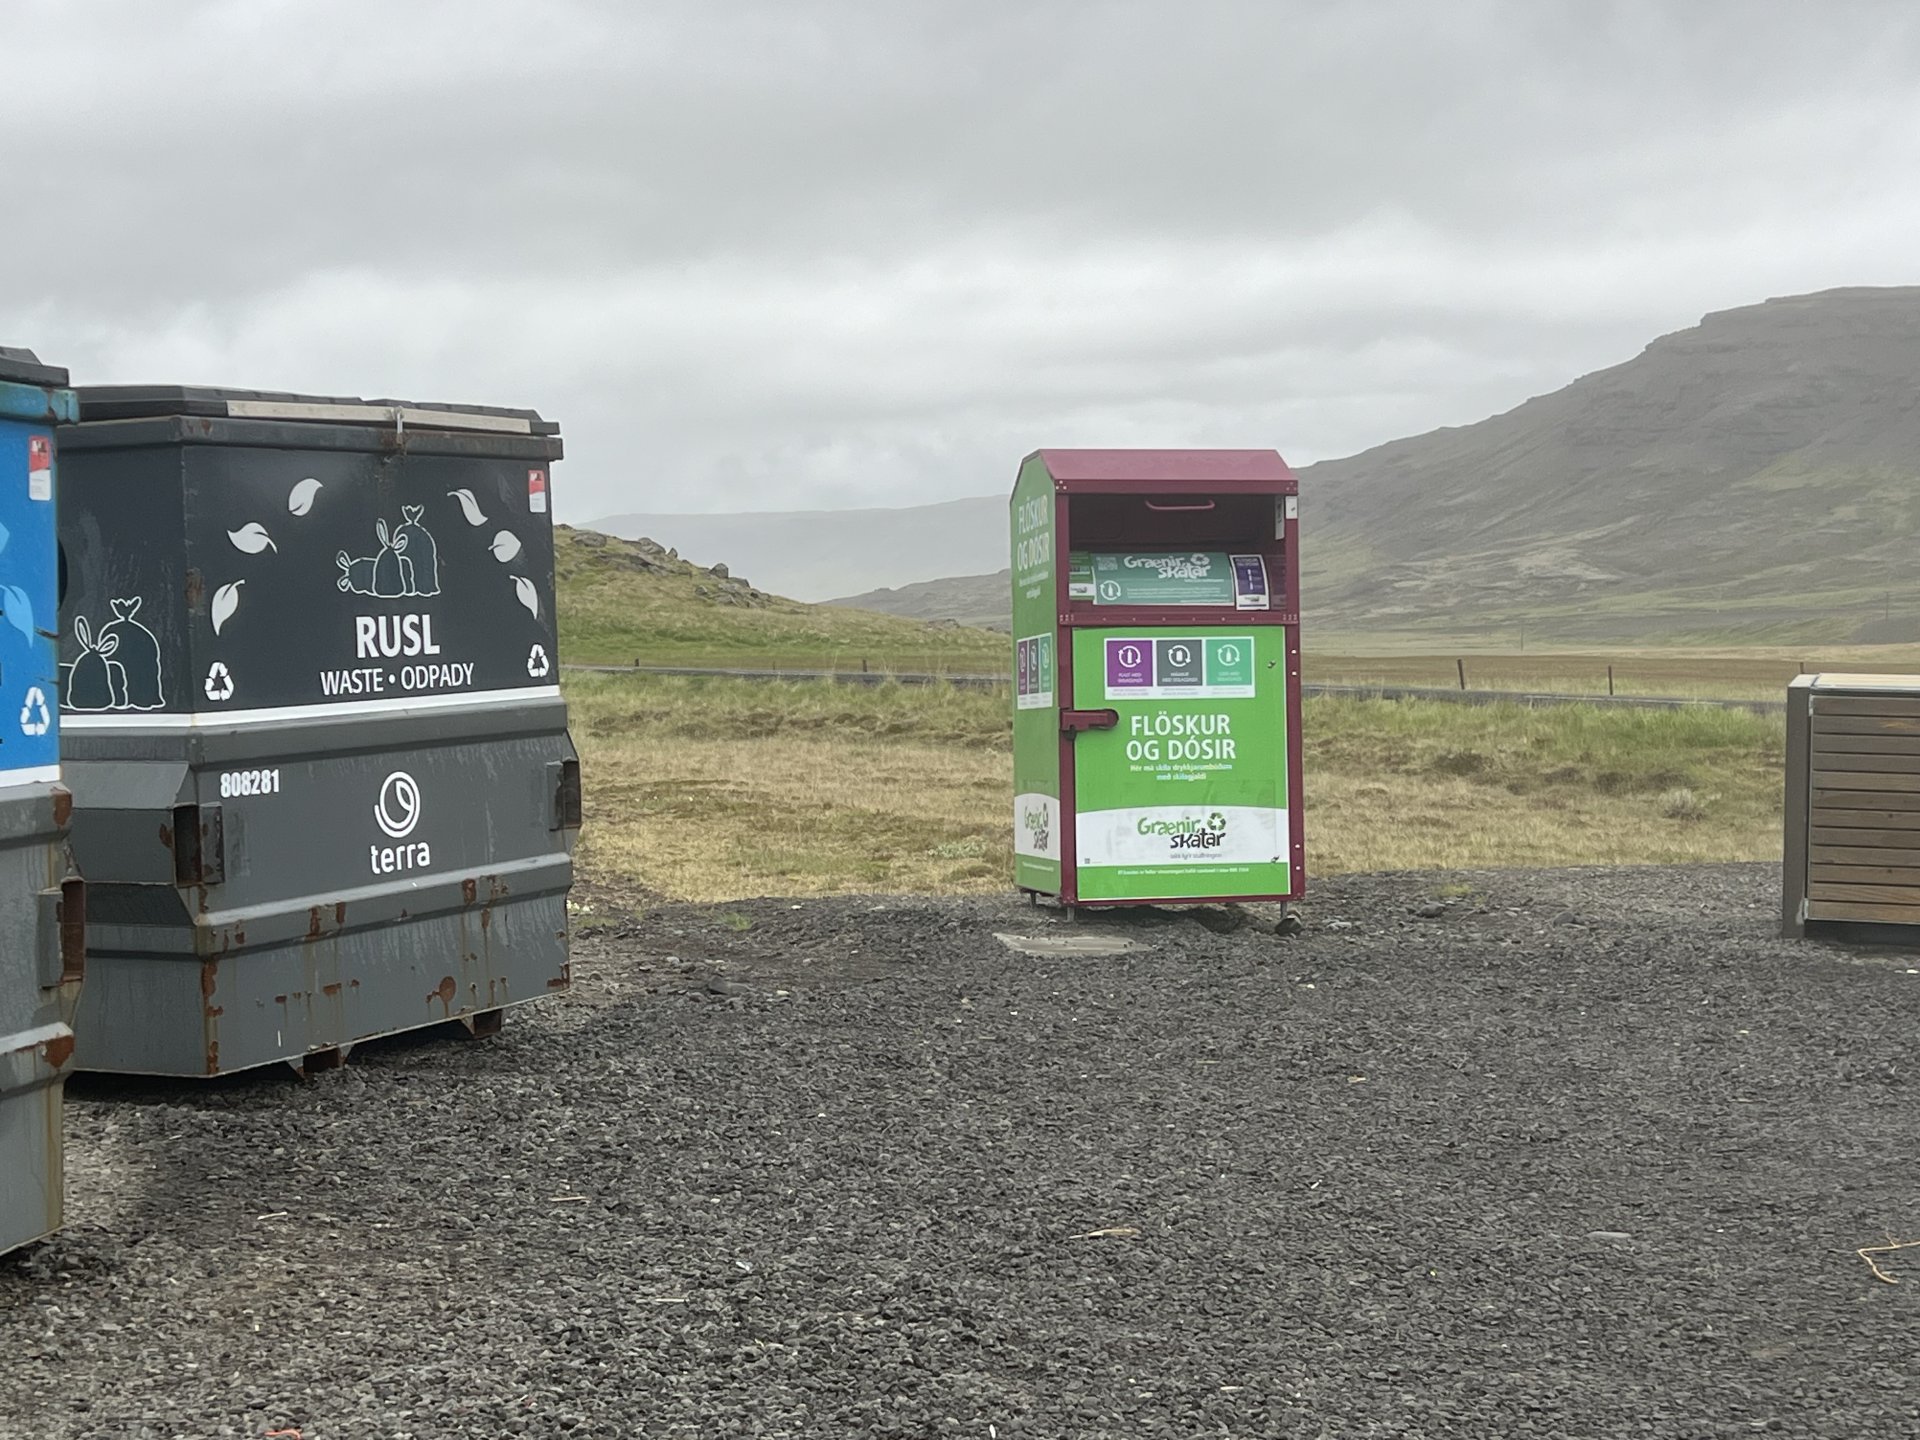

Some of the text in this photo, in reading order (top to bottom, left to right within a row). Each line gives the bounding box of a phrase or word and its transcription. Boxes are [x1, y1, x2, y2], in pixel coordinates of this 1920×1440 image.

[1017, 540, 1028, 572] OG
[356, 614, 440, 658] RUSL
[320, 662, 474, 695] WASTE ODPADY
[1130, 710, 1231, 736] FLÖSKUR
[1126, 735, 1236, 761] OG DÓSIR
[220, 769, 280, 798] 808281
[1170, 827, 1226, 849] skátar
[370, 842, 430, 874] terra
